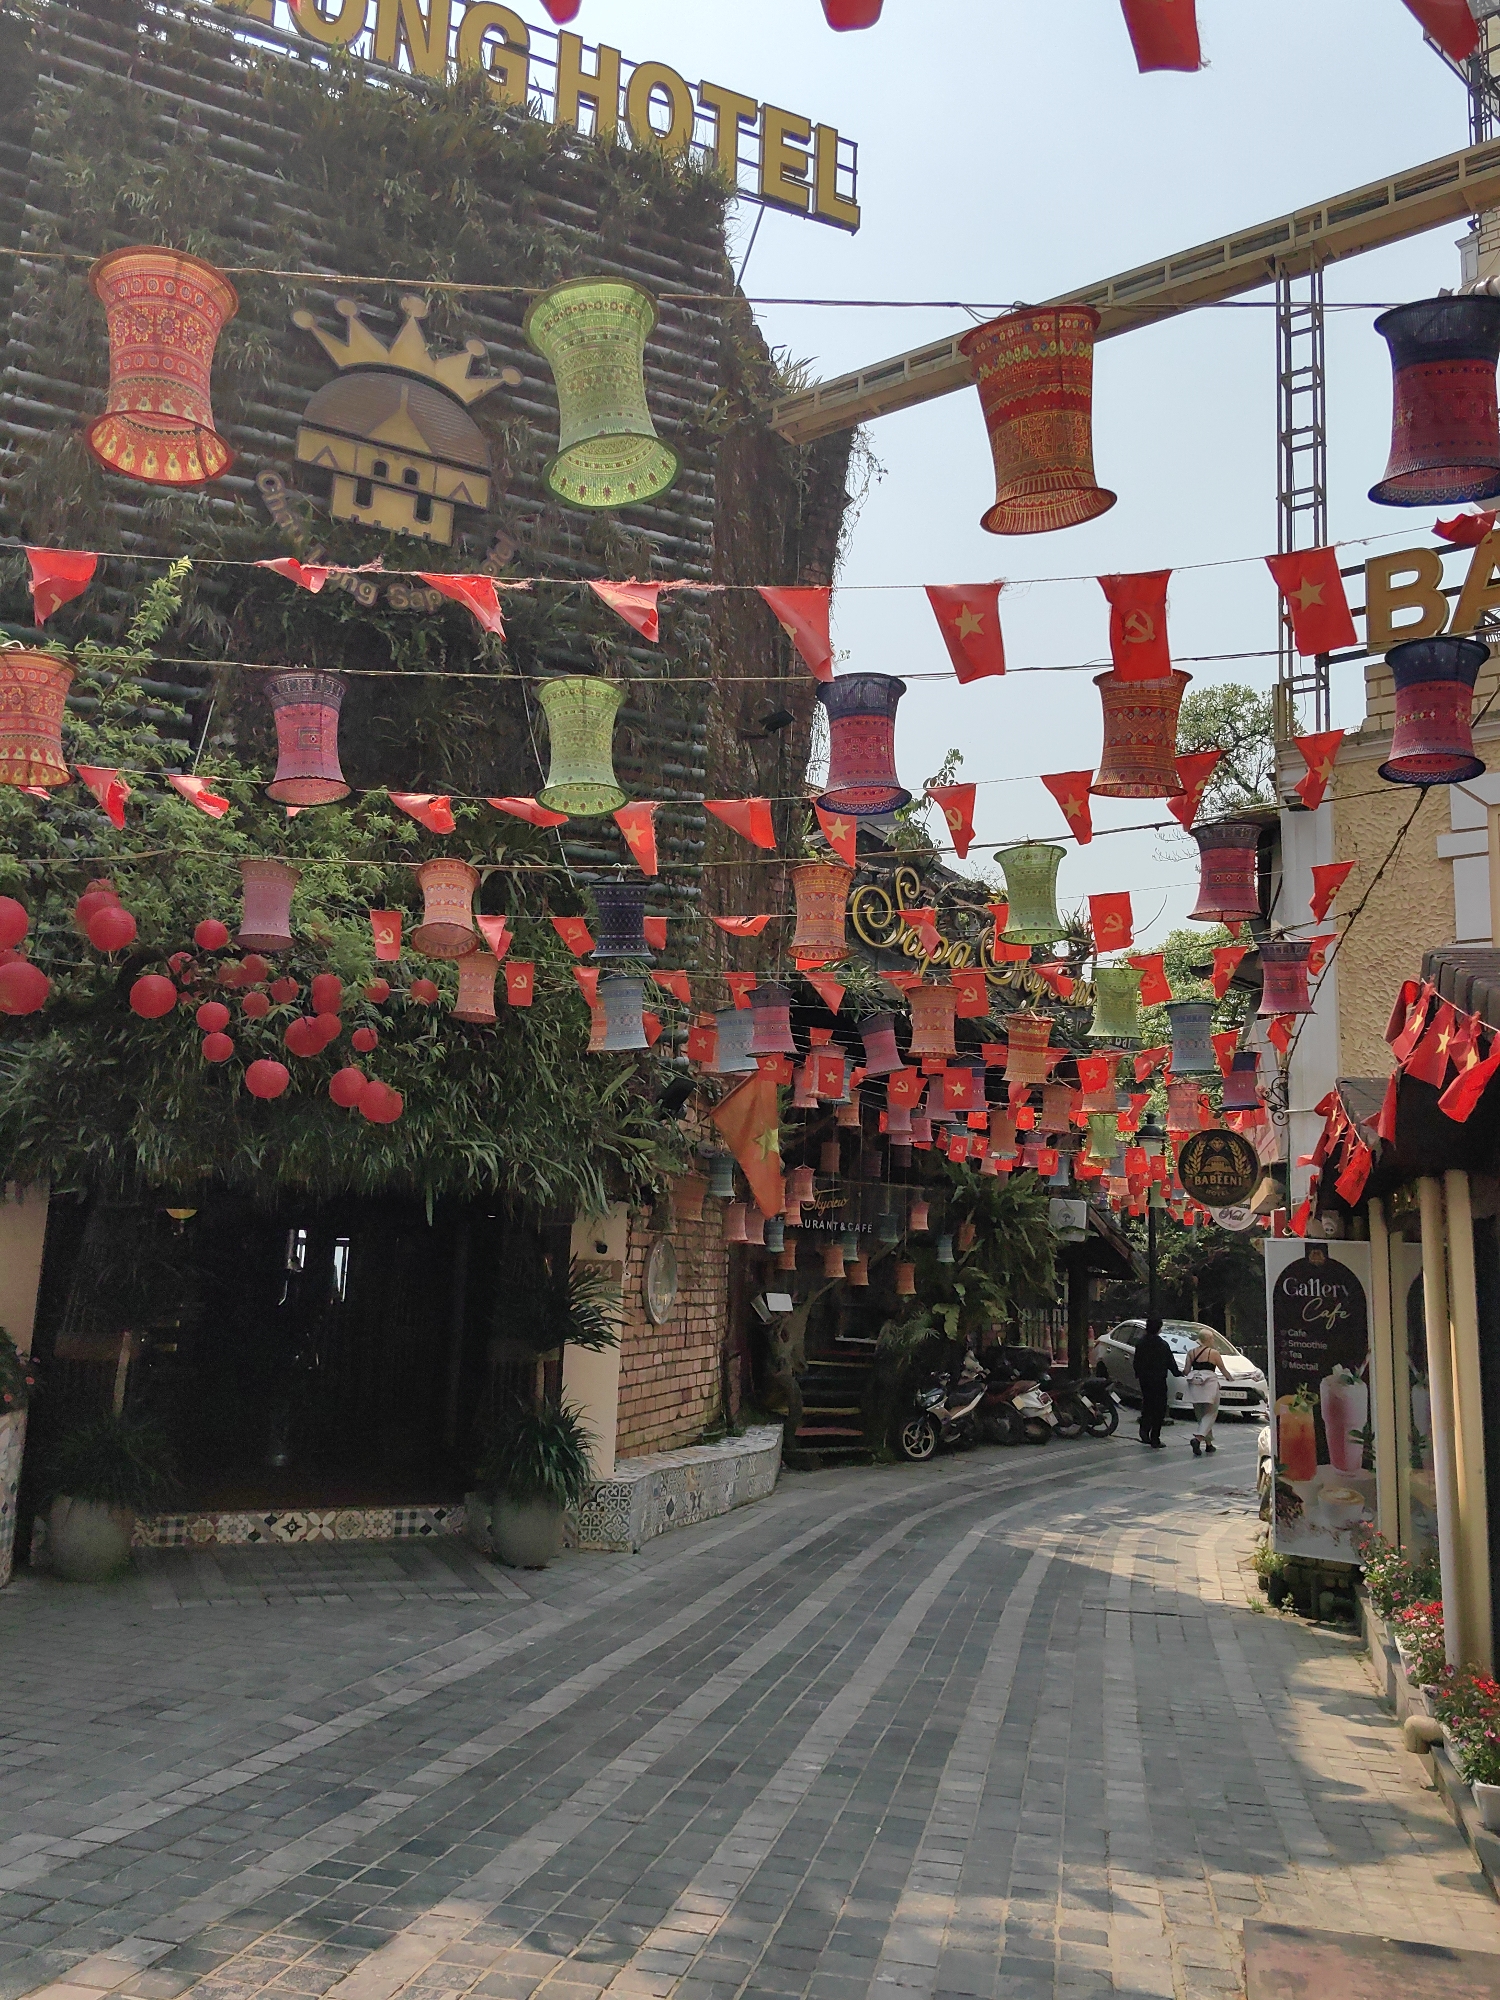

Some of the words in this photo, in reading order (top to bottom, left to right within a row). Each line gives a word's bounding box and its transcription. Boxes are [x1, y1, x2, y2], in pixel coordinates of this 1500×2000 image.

[247, 0, 531, 104] ONG
[554, 29, 860, 234] HOTEL
[387, 583, 444, 613] Sap
[481, 530, 517, 577] otel
[1365, 529, 1500, 655] BA
[849, 866, 973, 977] Sapa
[1282, 1277, 1349, 1299] Gallery
[1302, 1297, 1350, 1330] Cafe
[1287, 1328, 1307, 1338] Cafe
[1288, 1339, 1328, 1350] Smoothie
[1288, 1361, 1319, 1371] Moctail
[1289, 1350, 1303, 1359] Tea
